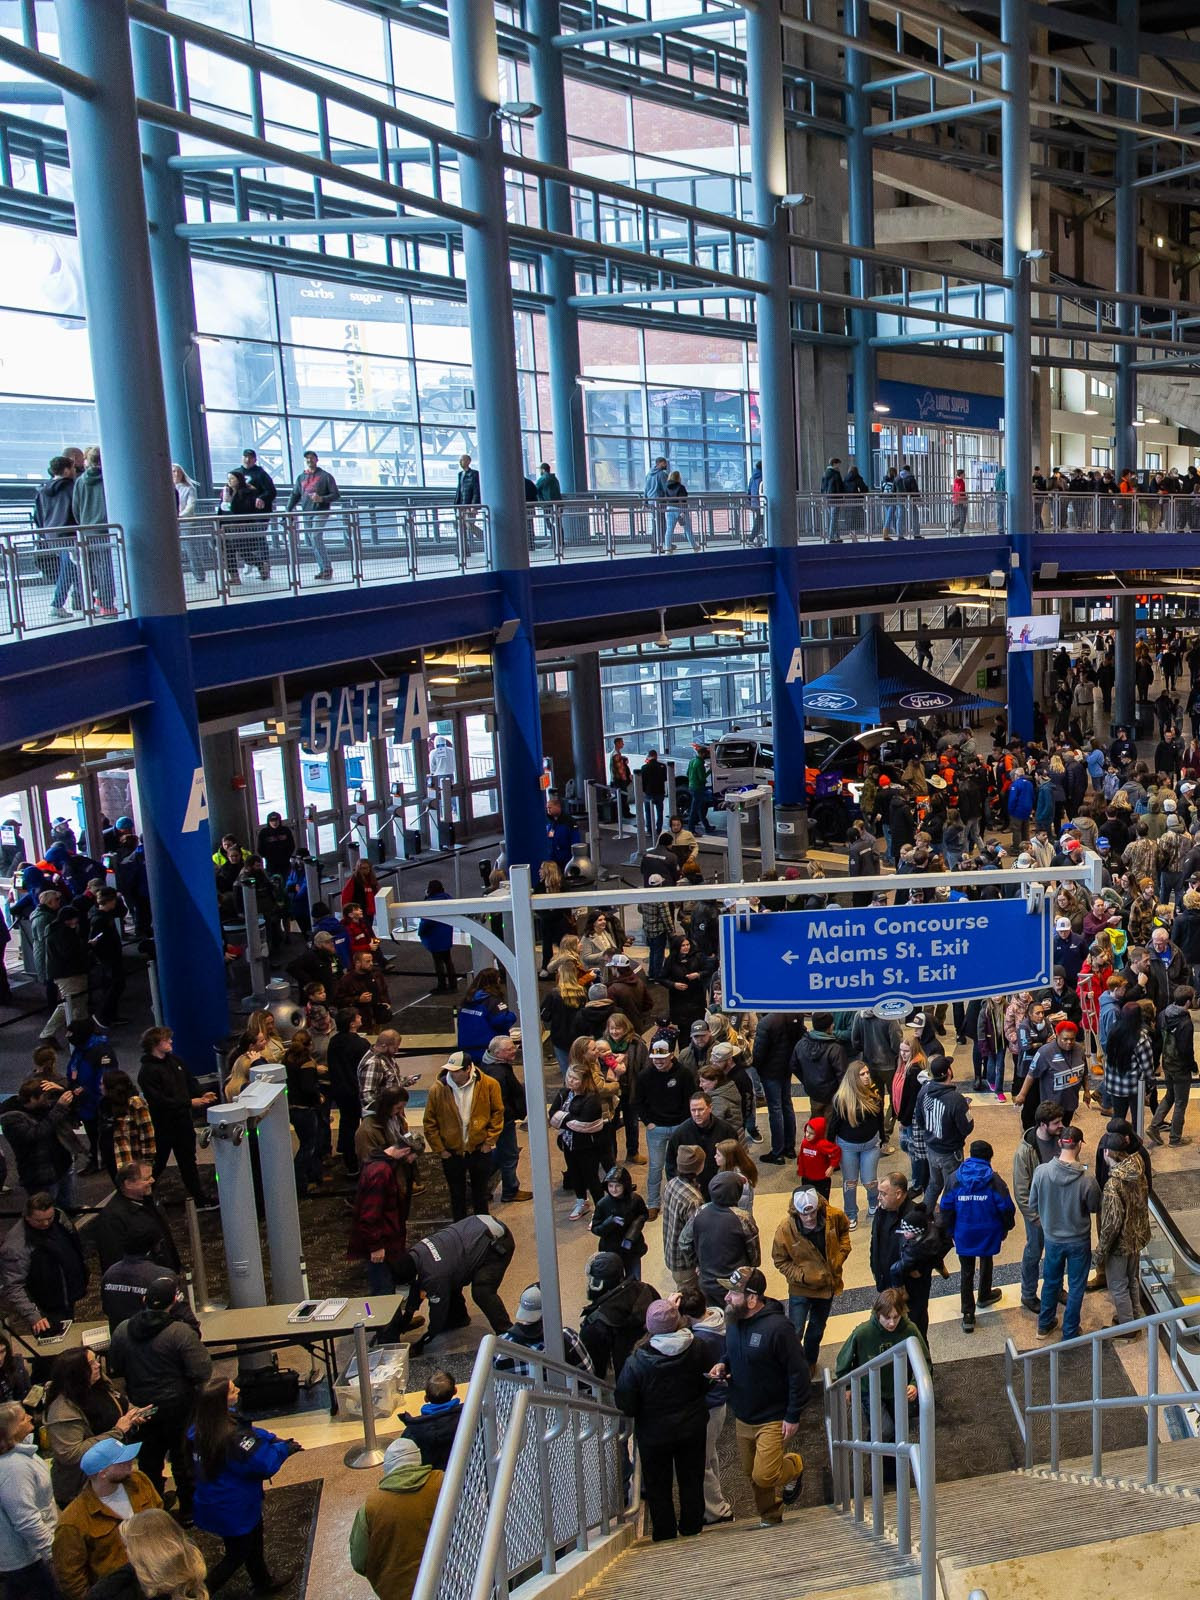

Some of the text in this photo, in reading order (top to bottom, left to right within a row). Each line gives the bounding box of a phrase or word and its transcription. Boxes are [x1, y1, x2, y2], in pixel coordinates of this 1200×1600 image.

[300, 288, 335, 300] carbs
[350, 292, 384, 305] sugar
[310, 672, 430, 755] GATE A
[808, 695, 848, 709] Ford
[910, 694, 944, 707] Ford
[807, 914, 989, 940] Main Concourse
[807, 937, 970, 965] Adams St. Exit
[808, 963, 957, 990] Brush St. Exit
